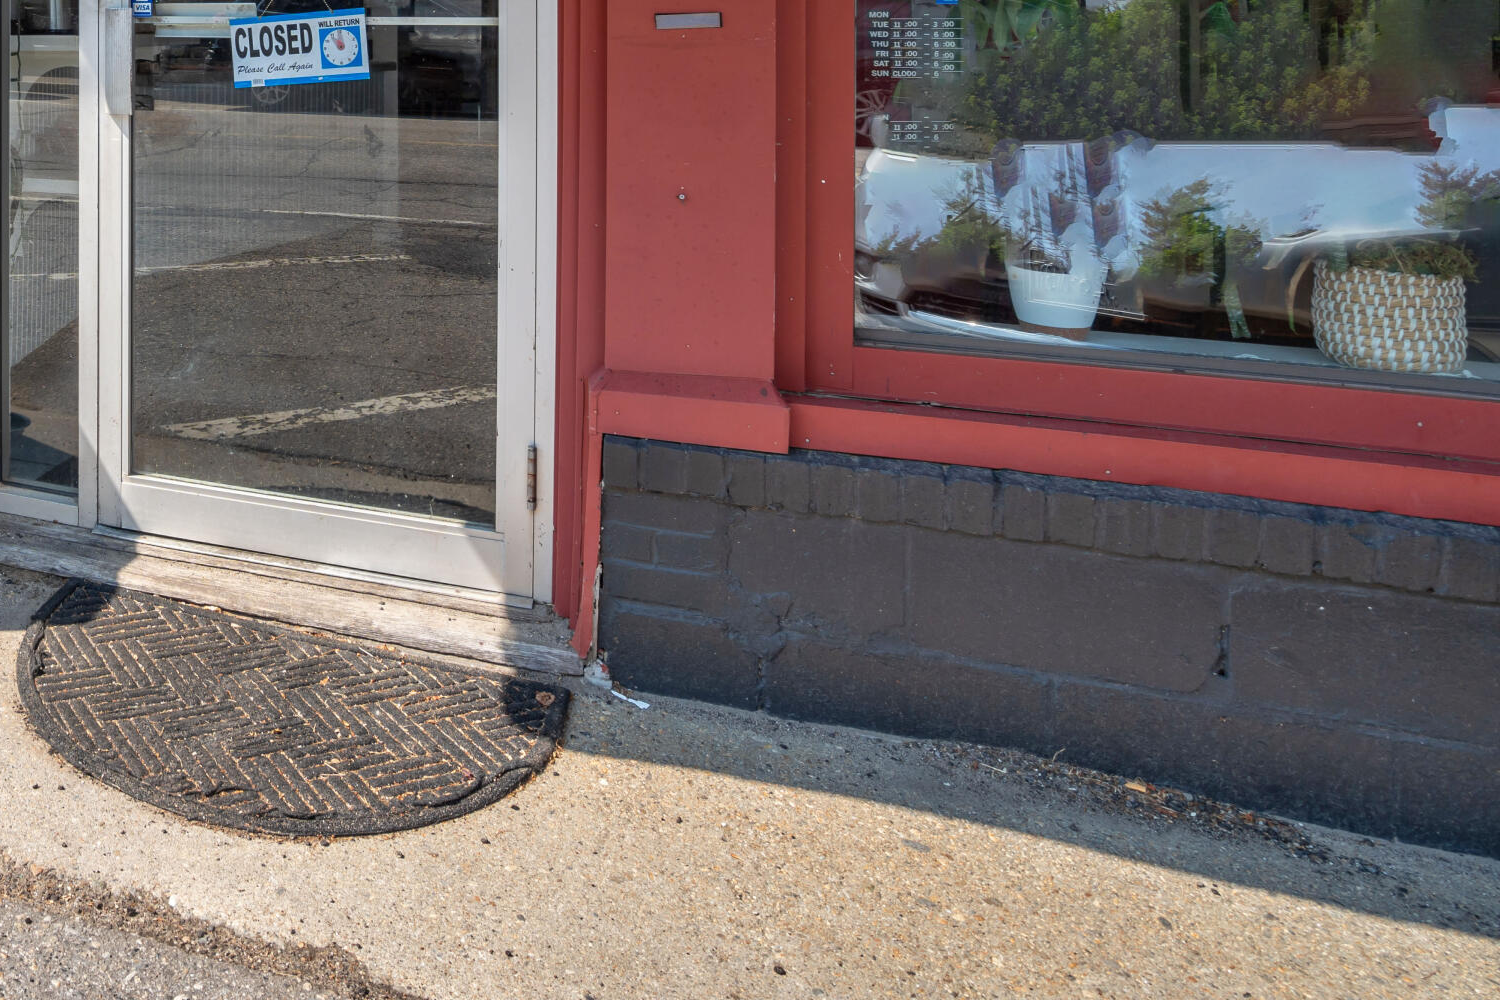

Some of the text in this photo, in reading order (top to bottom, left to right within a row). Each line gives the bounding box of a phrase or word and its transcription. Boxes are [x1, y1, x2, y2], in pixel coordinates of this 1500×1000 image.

[334, 18, 359, 27] RETURN
[235, 23, 313, 58] CLOSED
[238, 62, 314, 74] Please Call Again
